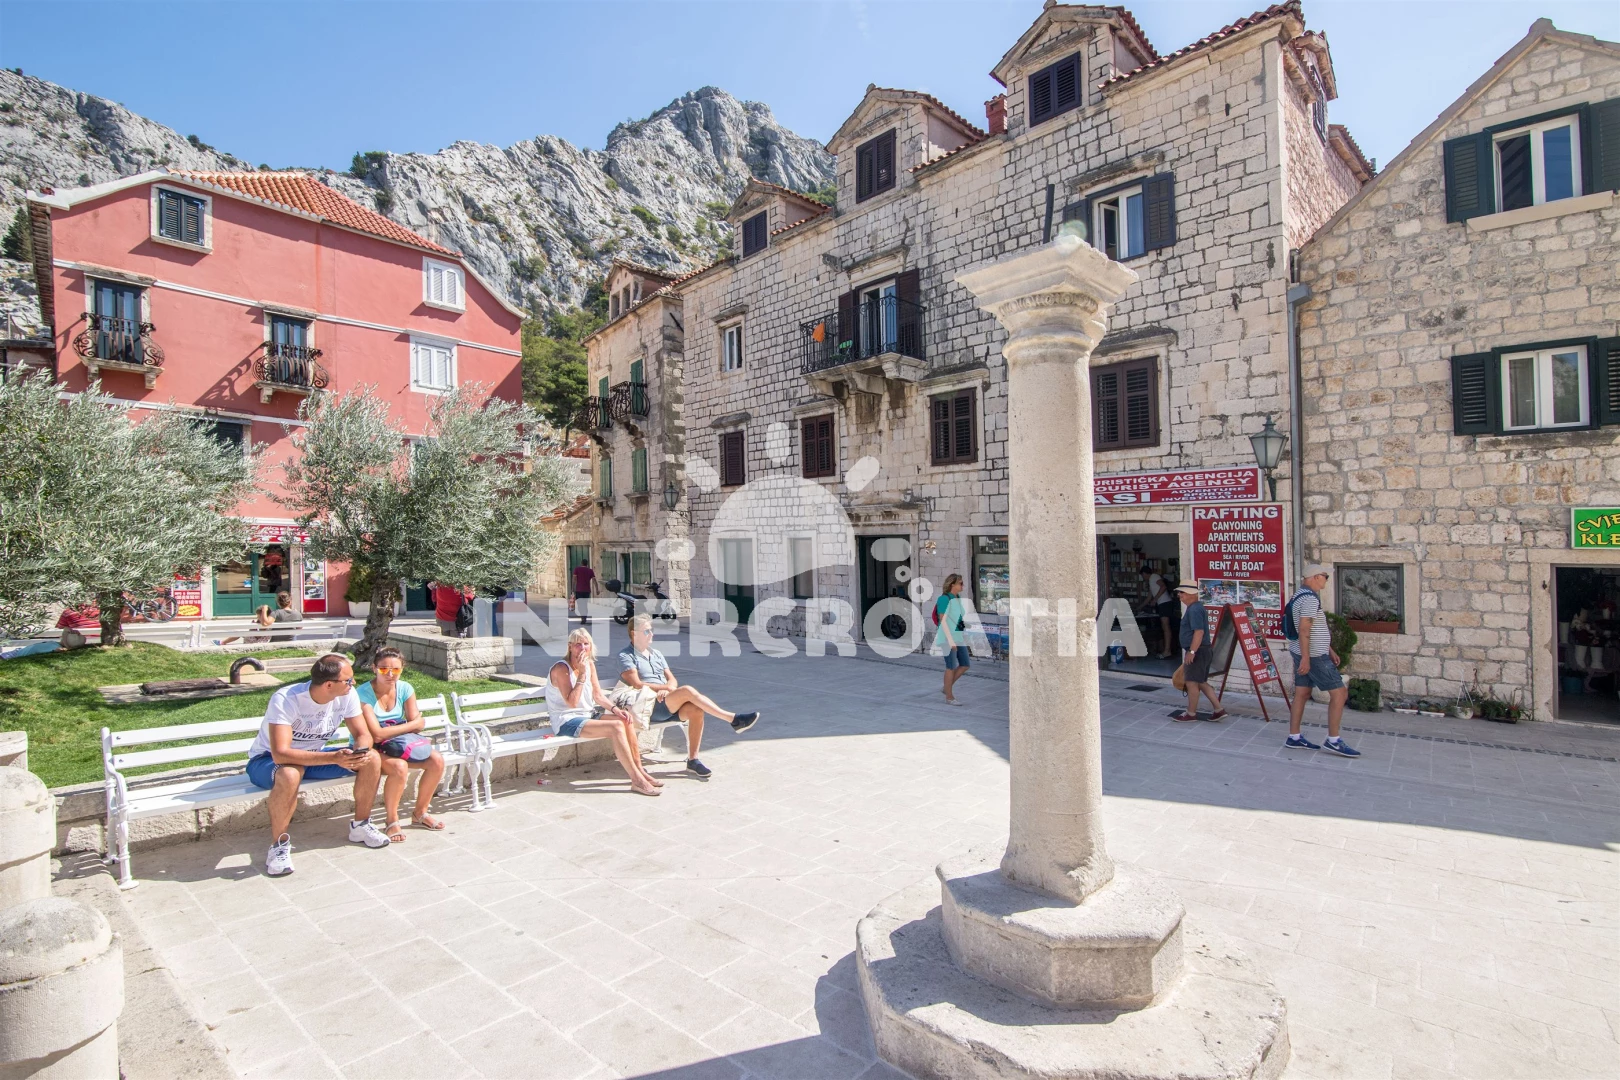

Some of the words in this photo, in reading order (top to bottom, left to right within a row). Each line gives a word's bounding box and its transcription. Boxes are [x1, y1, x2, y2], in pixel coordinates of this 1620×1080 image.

[1094, 476, 1168, 486] URISTIČKA
[1172, 470, 1254, 482] AGENCIJA
[1094, 482, 1161, 492] OURIST
[1167, 477, 1251, 488] AGENCY
[1171, 486, 1245, 494] ADVENTURE
[1161, 493, 1257, 501] INVESTIGATION
[1194, 506, 1278, 520] RAFTING
[1211, 520, 1263, 531] CANYONING
[1208, 532, 1265, 542] APARTMENTS
[1197, 543, 1220, 553] BOAT
[1221, 543, 1277, 553] EXCURSIONS
[1209, 560, 1231, 570] RENT
[1233, 561, 1240, 571] A
[1241, 561, 1265, 571] BOAT
